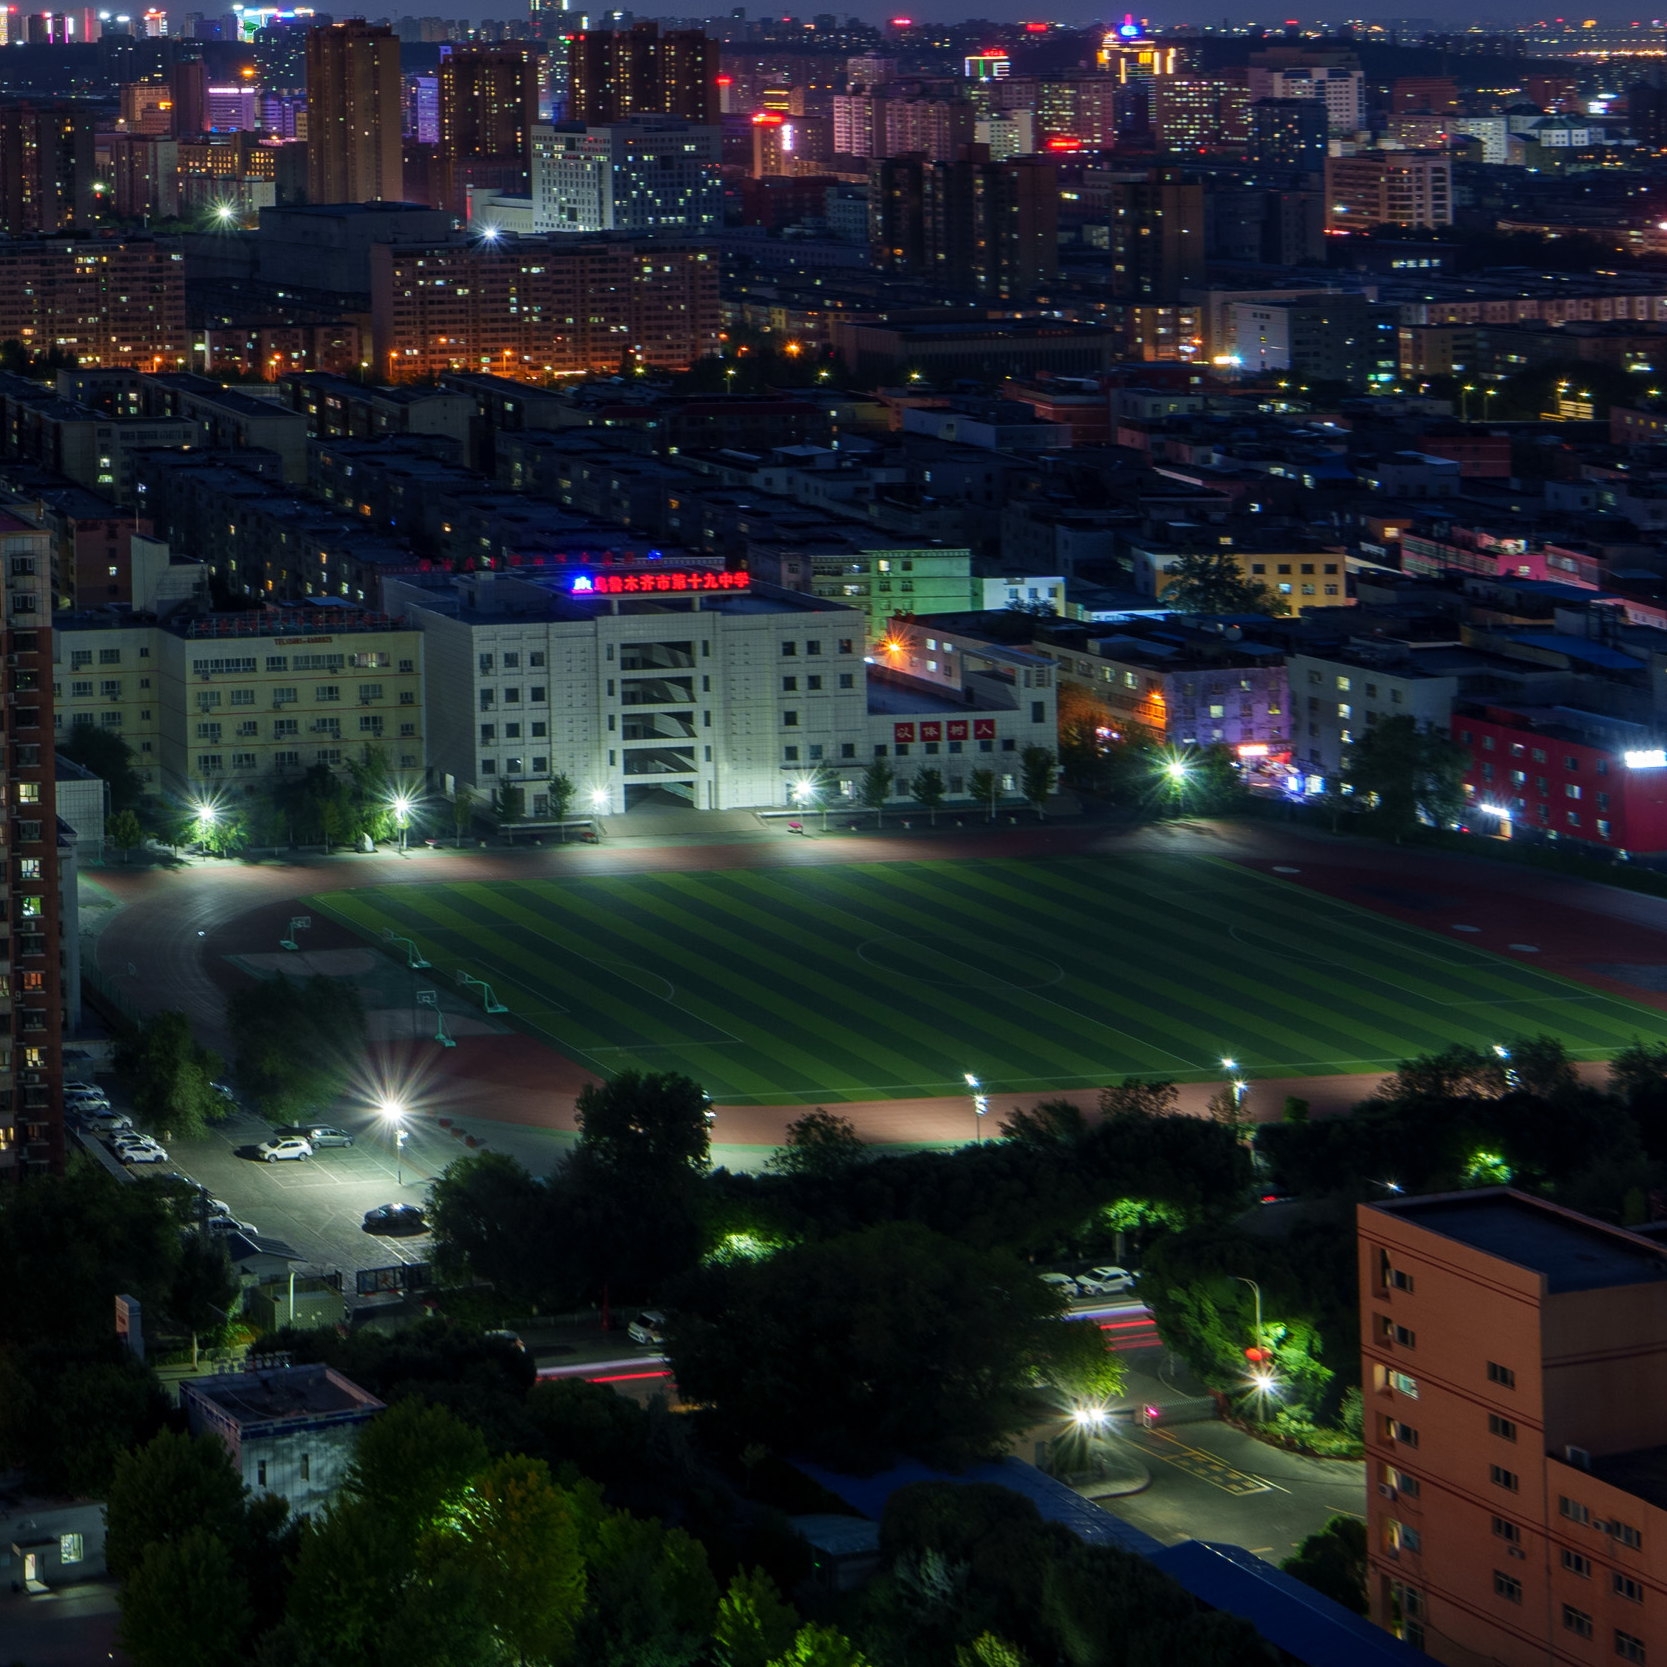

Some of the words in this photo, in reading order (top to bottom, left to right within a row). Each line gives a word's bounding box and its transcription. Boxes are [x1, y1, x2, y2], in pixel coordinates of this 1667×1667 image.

[594, 572, 750, 593] 乌鲁木齐市第十九中学
